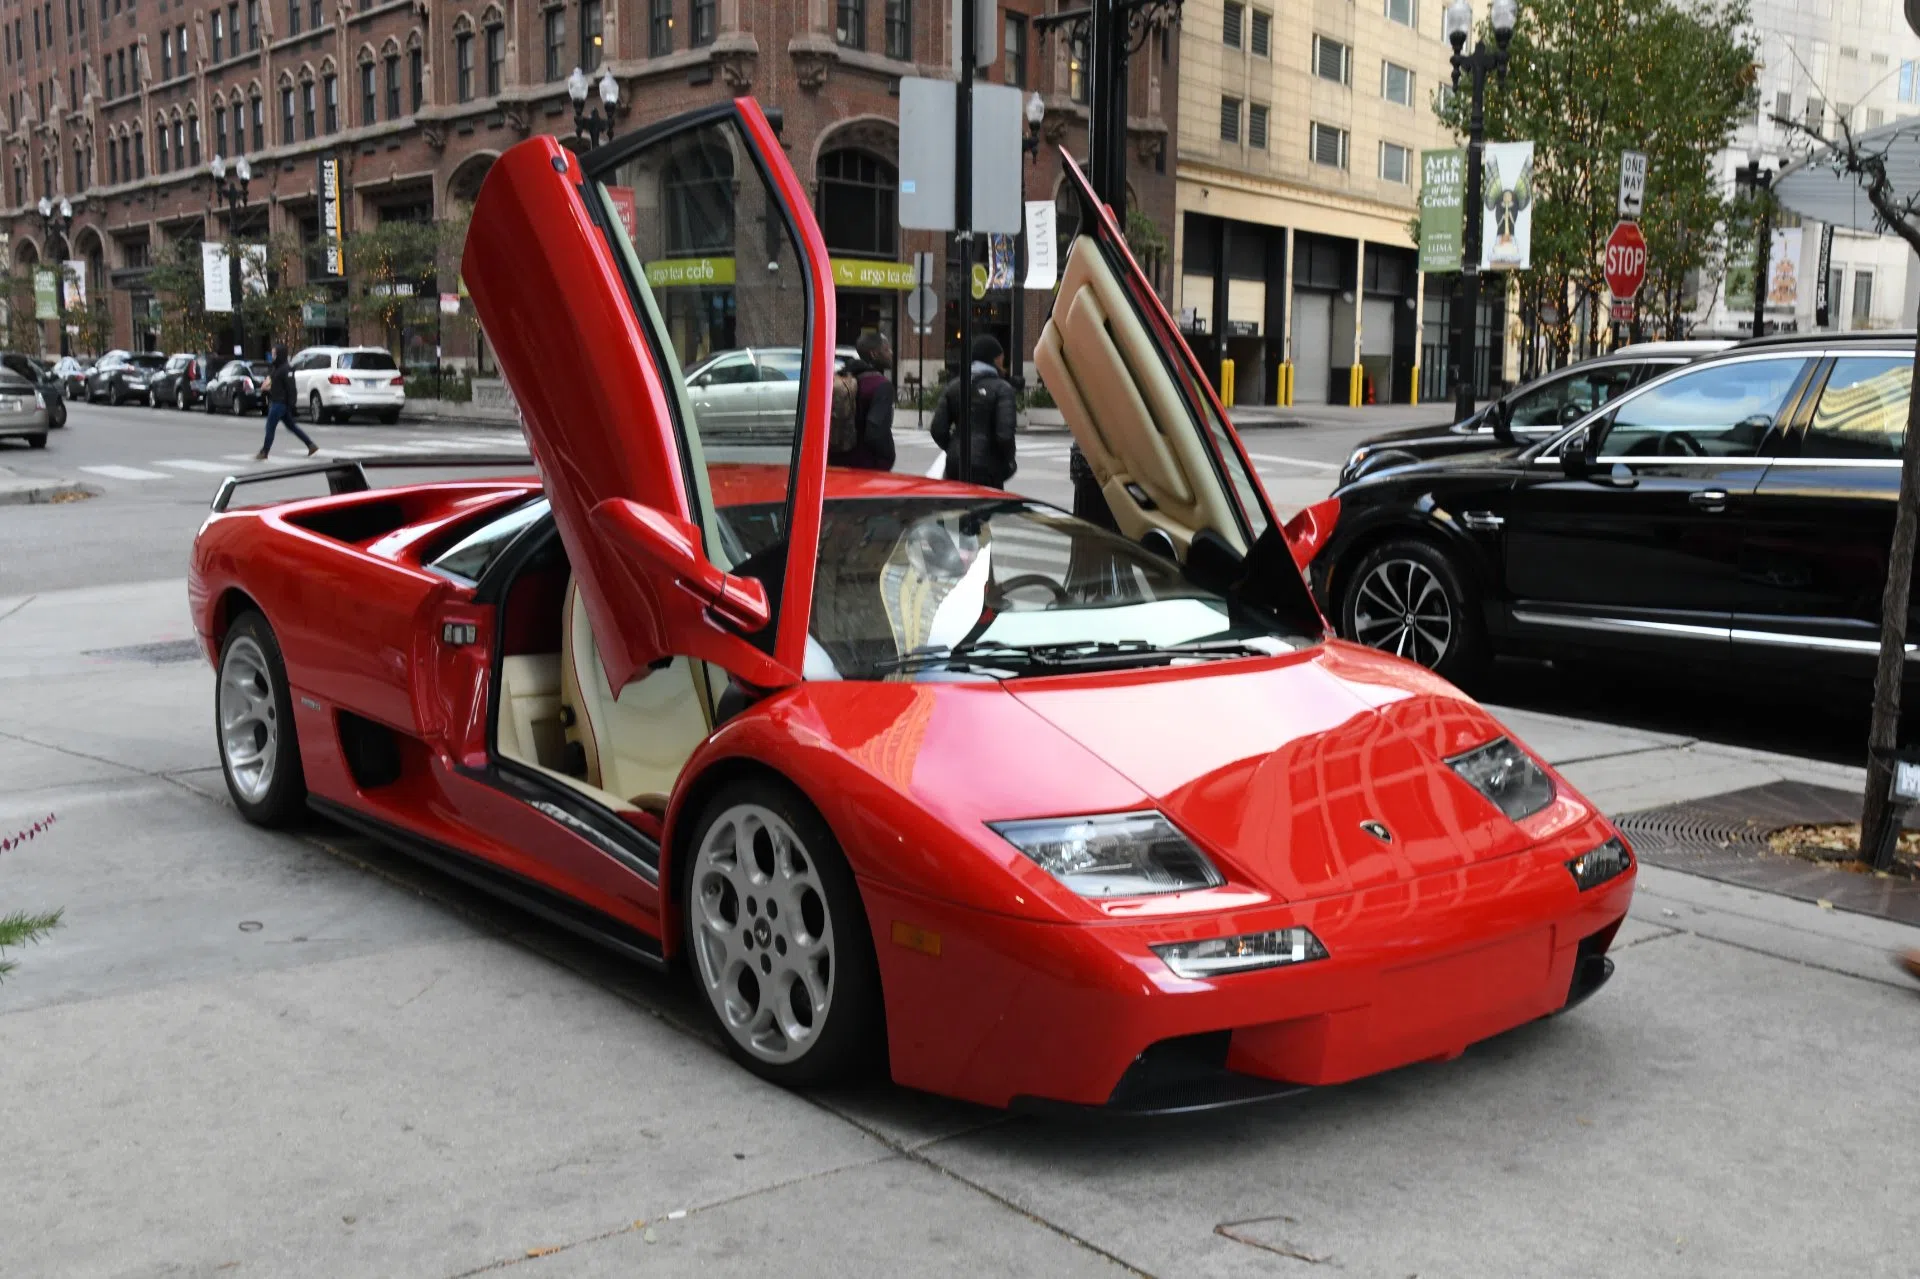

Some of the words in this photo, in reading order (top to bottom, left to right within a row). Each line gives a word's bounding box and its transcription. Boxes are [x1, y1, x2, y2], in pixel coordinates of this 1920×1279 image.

[1425, 156, 1448, 169] Art
[1451, 156, 1460, 169] &
[1625, 158, 1643, 174] ONE
[323, 160, 335, 198] BAGELS
[1426, 169, 1459, 184] Faith
[1623, 174, 1643, 191] WAY
[1423, 195, 1460, 208] Creche
[1034, 207, 1049, 268] LUMA
[1607, 244, 1644, 277] STOP
[653, 267, 669, 284] argo
[670, 265, 683, 279] tea
[860, 267, 886, 286] argo
[888, 268, 900, 284] tea
[902, 265, 917, 285] caf
